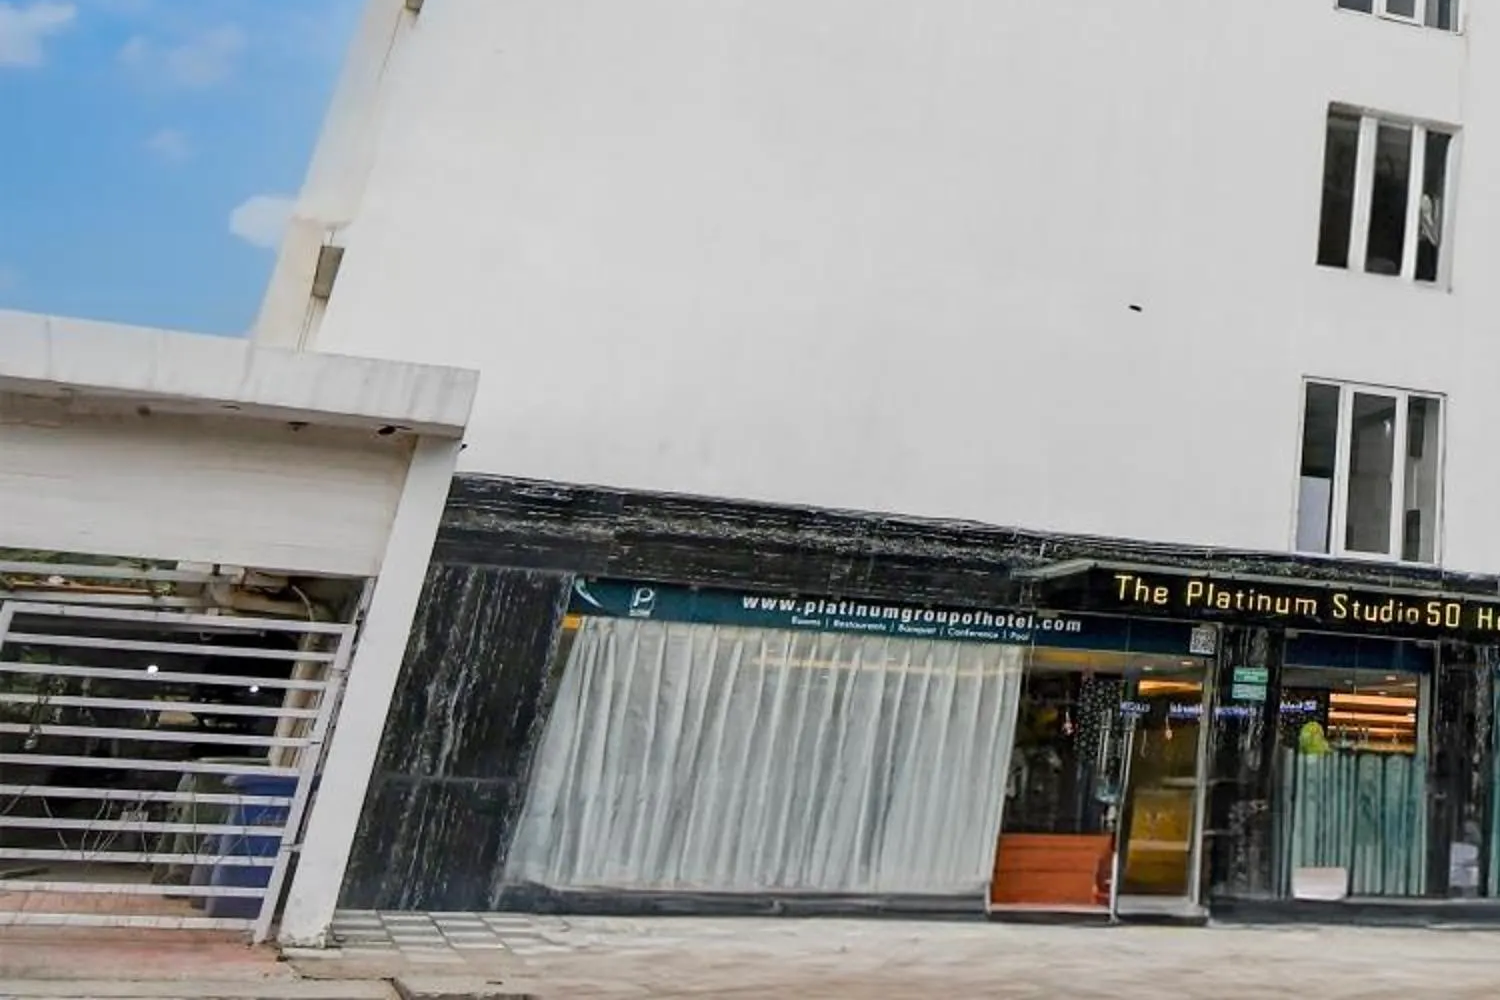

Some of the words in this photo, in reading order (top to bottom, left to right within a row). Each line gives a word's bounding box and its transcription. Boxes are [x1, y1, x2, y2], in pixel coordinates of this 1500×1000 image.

[1114, 574, 1169, 605] The
[1186, 581, 1317, 616] Platinum
[742, 596, 1082, 633] www.platinumgroupofhotel.com
[947, 626, 999, 639] Conference
